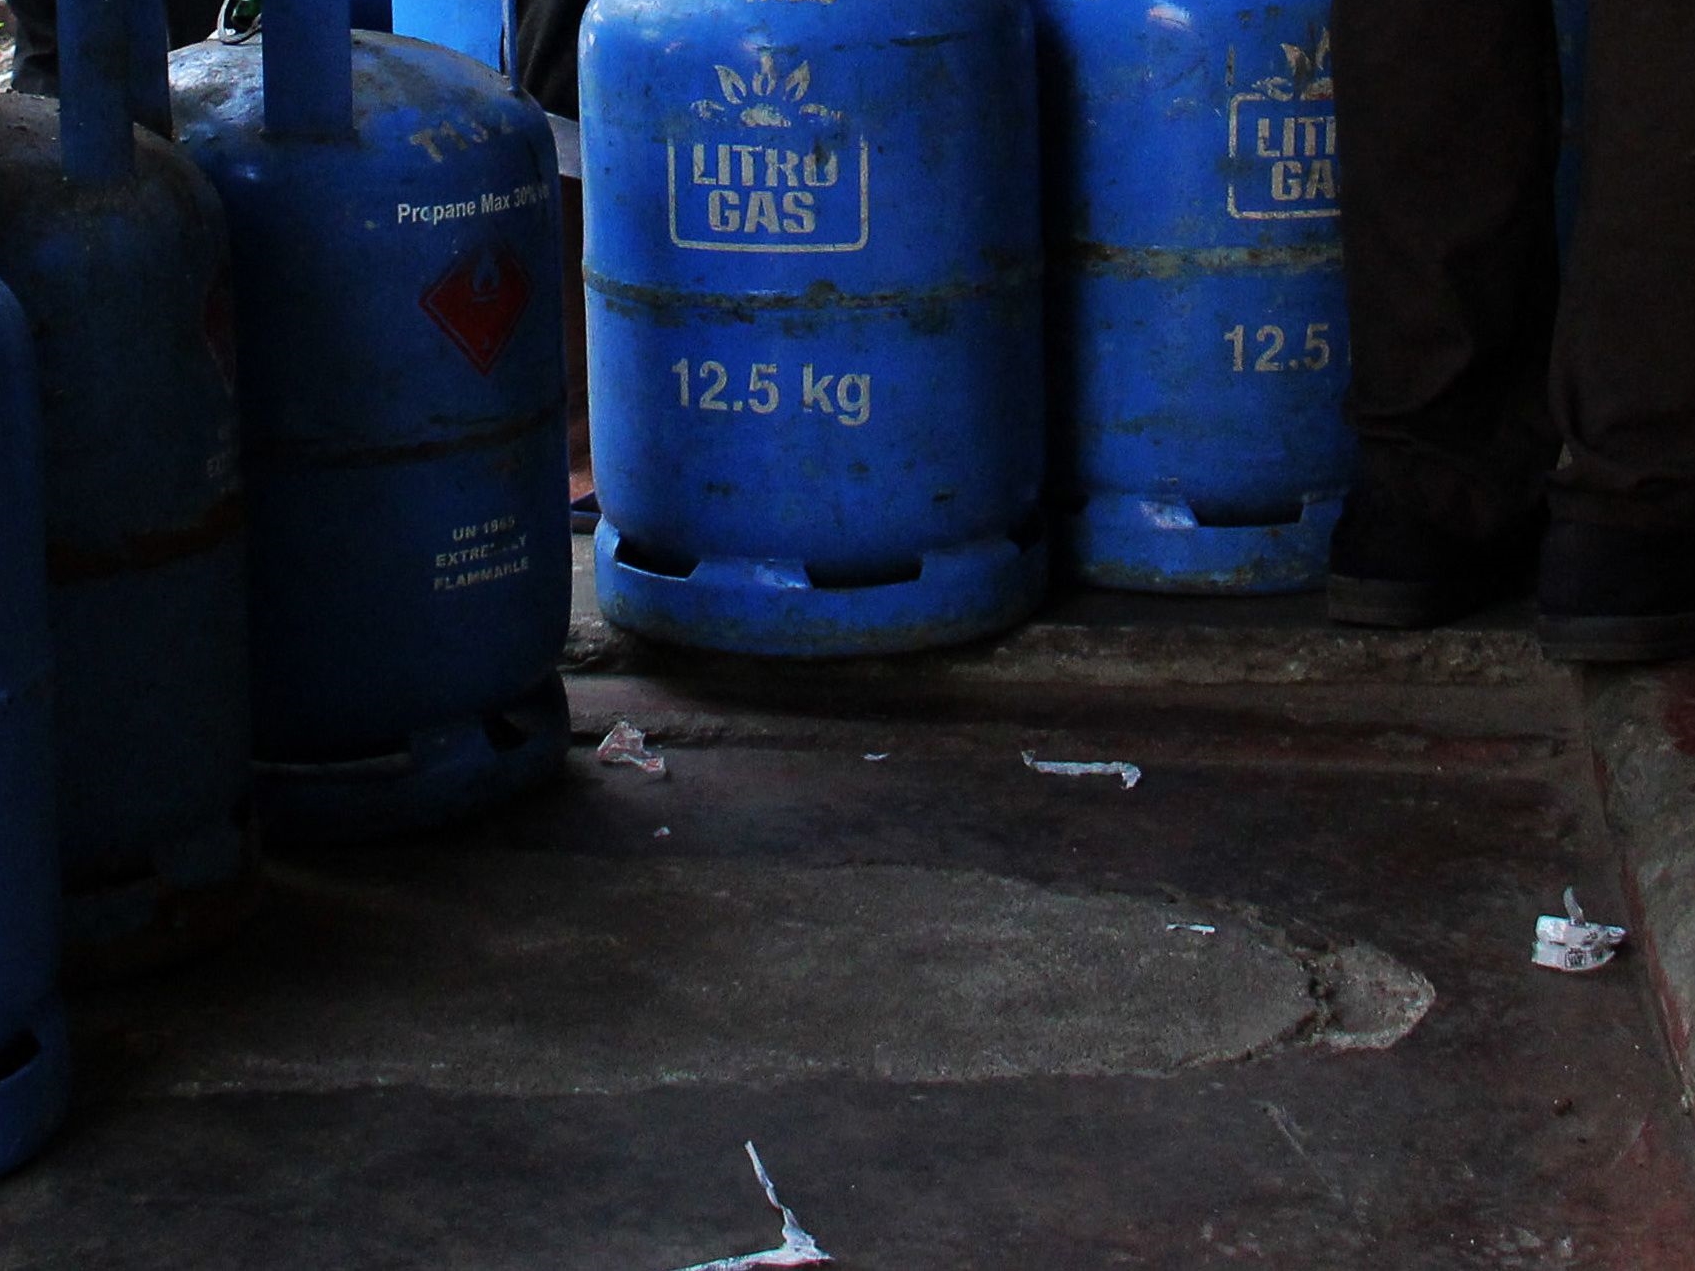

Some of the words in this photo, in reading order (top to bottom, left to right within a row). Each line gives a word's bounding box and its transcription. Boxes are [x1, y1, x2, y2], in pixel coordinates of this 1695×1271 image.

[693, 143, 839, 188] LITRO
[1270, 159, 1341, 201] GA
[397, 200, 476, 226] Propane
[480, 192, 511, 214] Max
[708, 189, 817, 234] GAS
[1223, 322, 1331, 372] 12.5
[672, 359, 780, 414] 12.5
[802, 363, 872, 426] kg
[435, 533, 527, 569] EXTREY
[452, 525, 477, 542] UN
